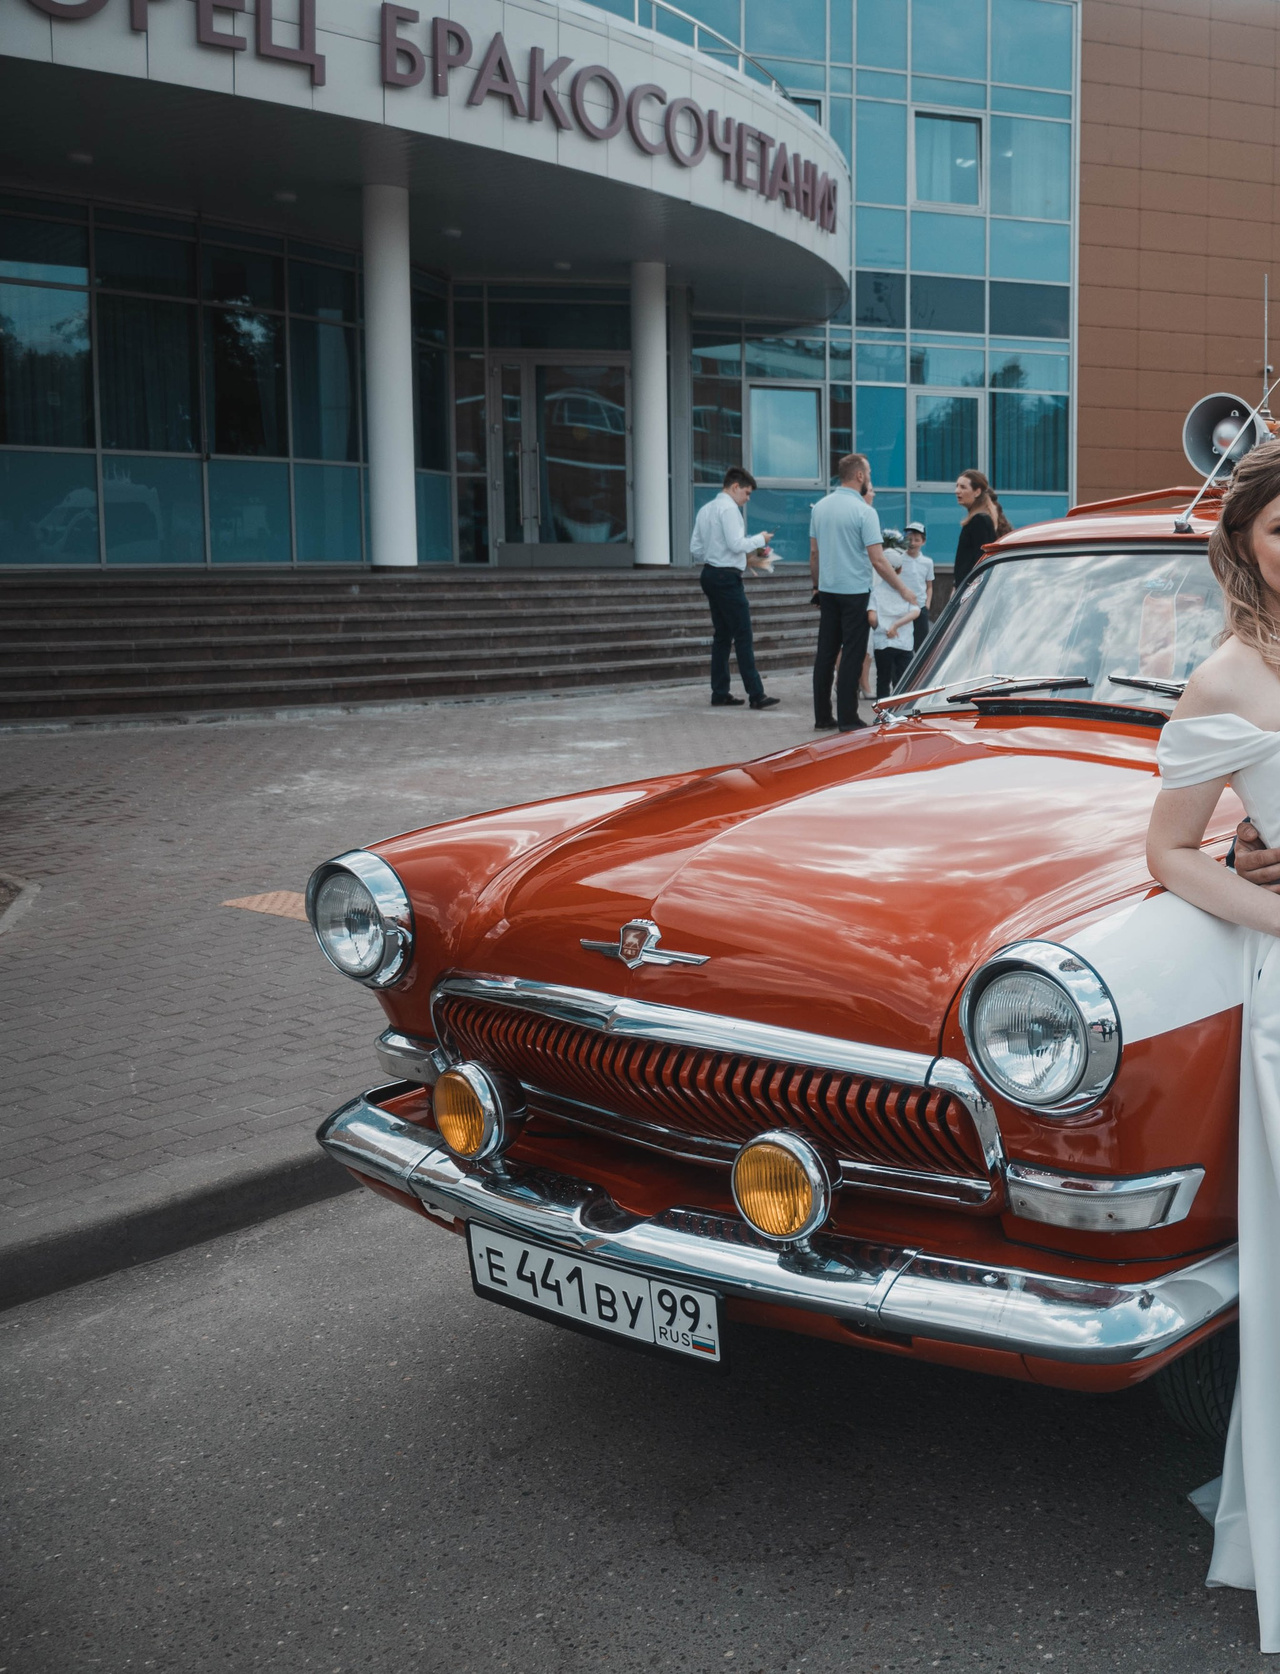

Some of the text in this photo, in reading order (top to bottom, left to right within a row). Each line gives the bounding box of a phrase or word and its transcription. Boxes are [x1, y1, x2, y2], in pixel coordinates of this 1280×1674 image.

[381, 3, 838, 235] БРАКОСОЧЕТАНИЯ
[657, 1289, 700, 1332] 99
[659, 1326, 691, 1347] RUS
